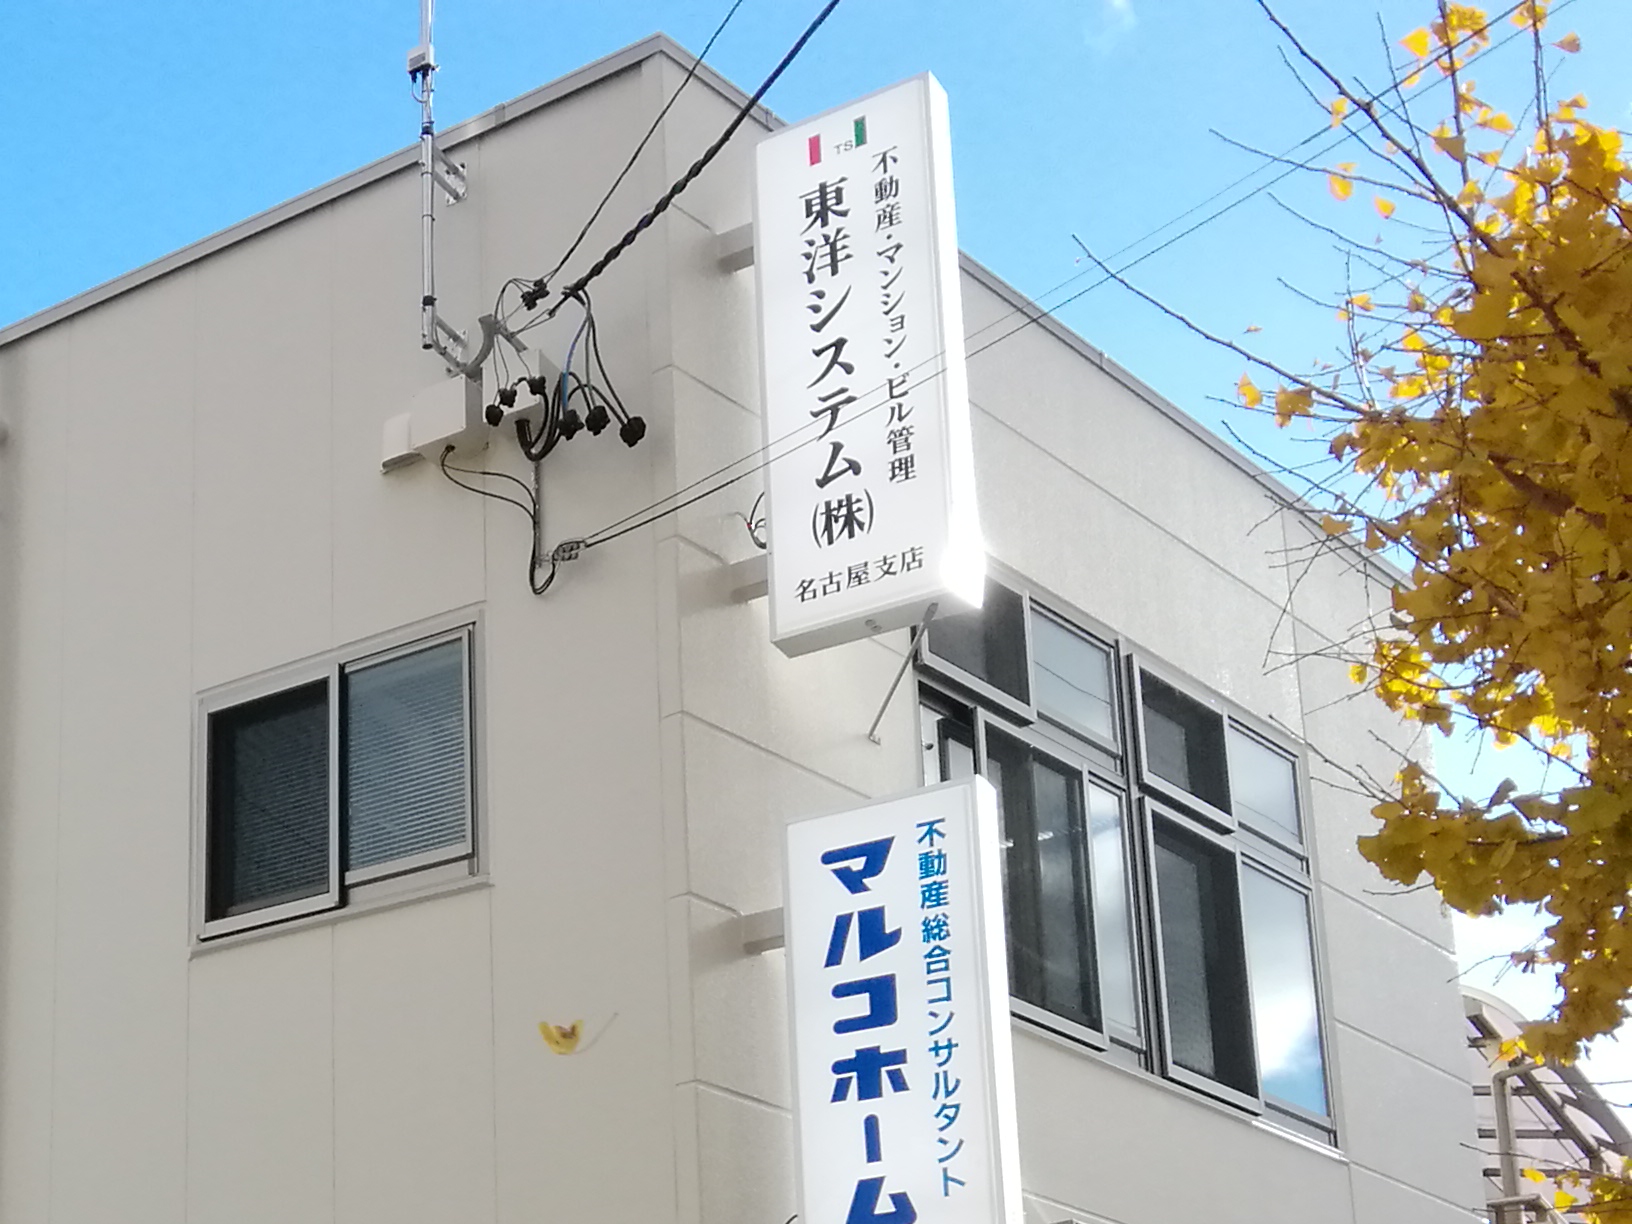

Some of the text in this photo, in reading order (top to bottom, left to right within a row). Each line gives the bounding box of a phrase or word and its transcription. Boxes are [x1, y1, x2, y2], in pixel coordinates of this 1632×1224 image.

[833, 139, 854, 155] TS
[871, 145, 917, 484] 不動産・マンション・ビル管理
[799, 174, 875, 549] 東洋システム(株)
[793, 545, 925, 604] 名古屋支店
[914, 816, 968, 1199] 不動産総合コンサルタント
